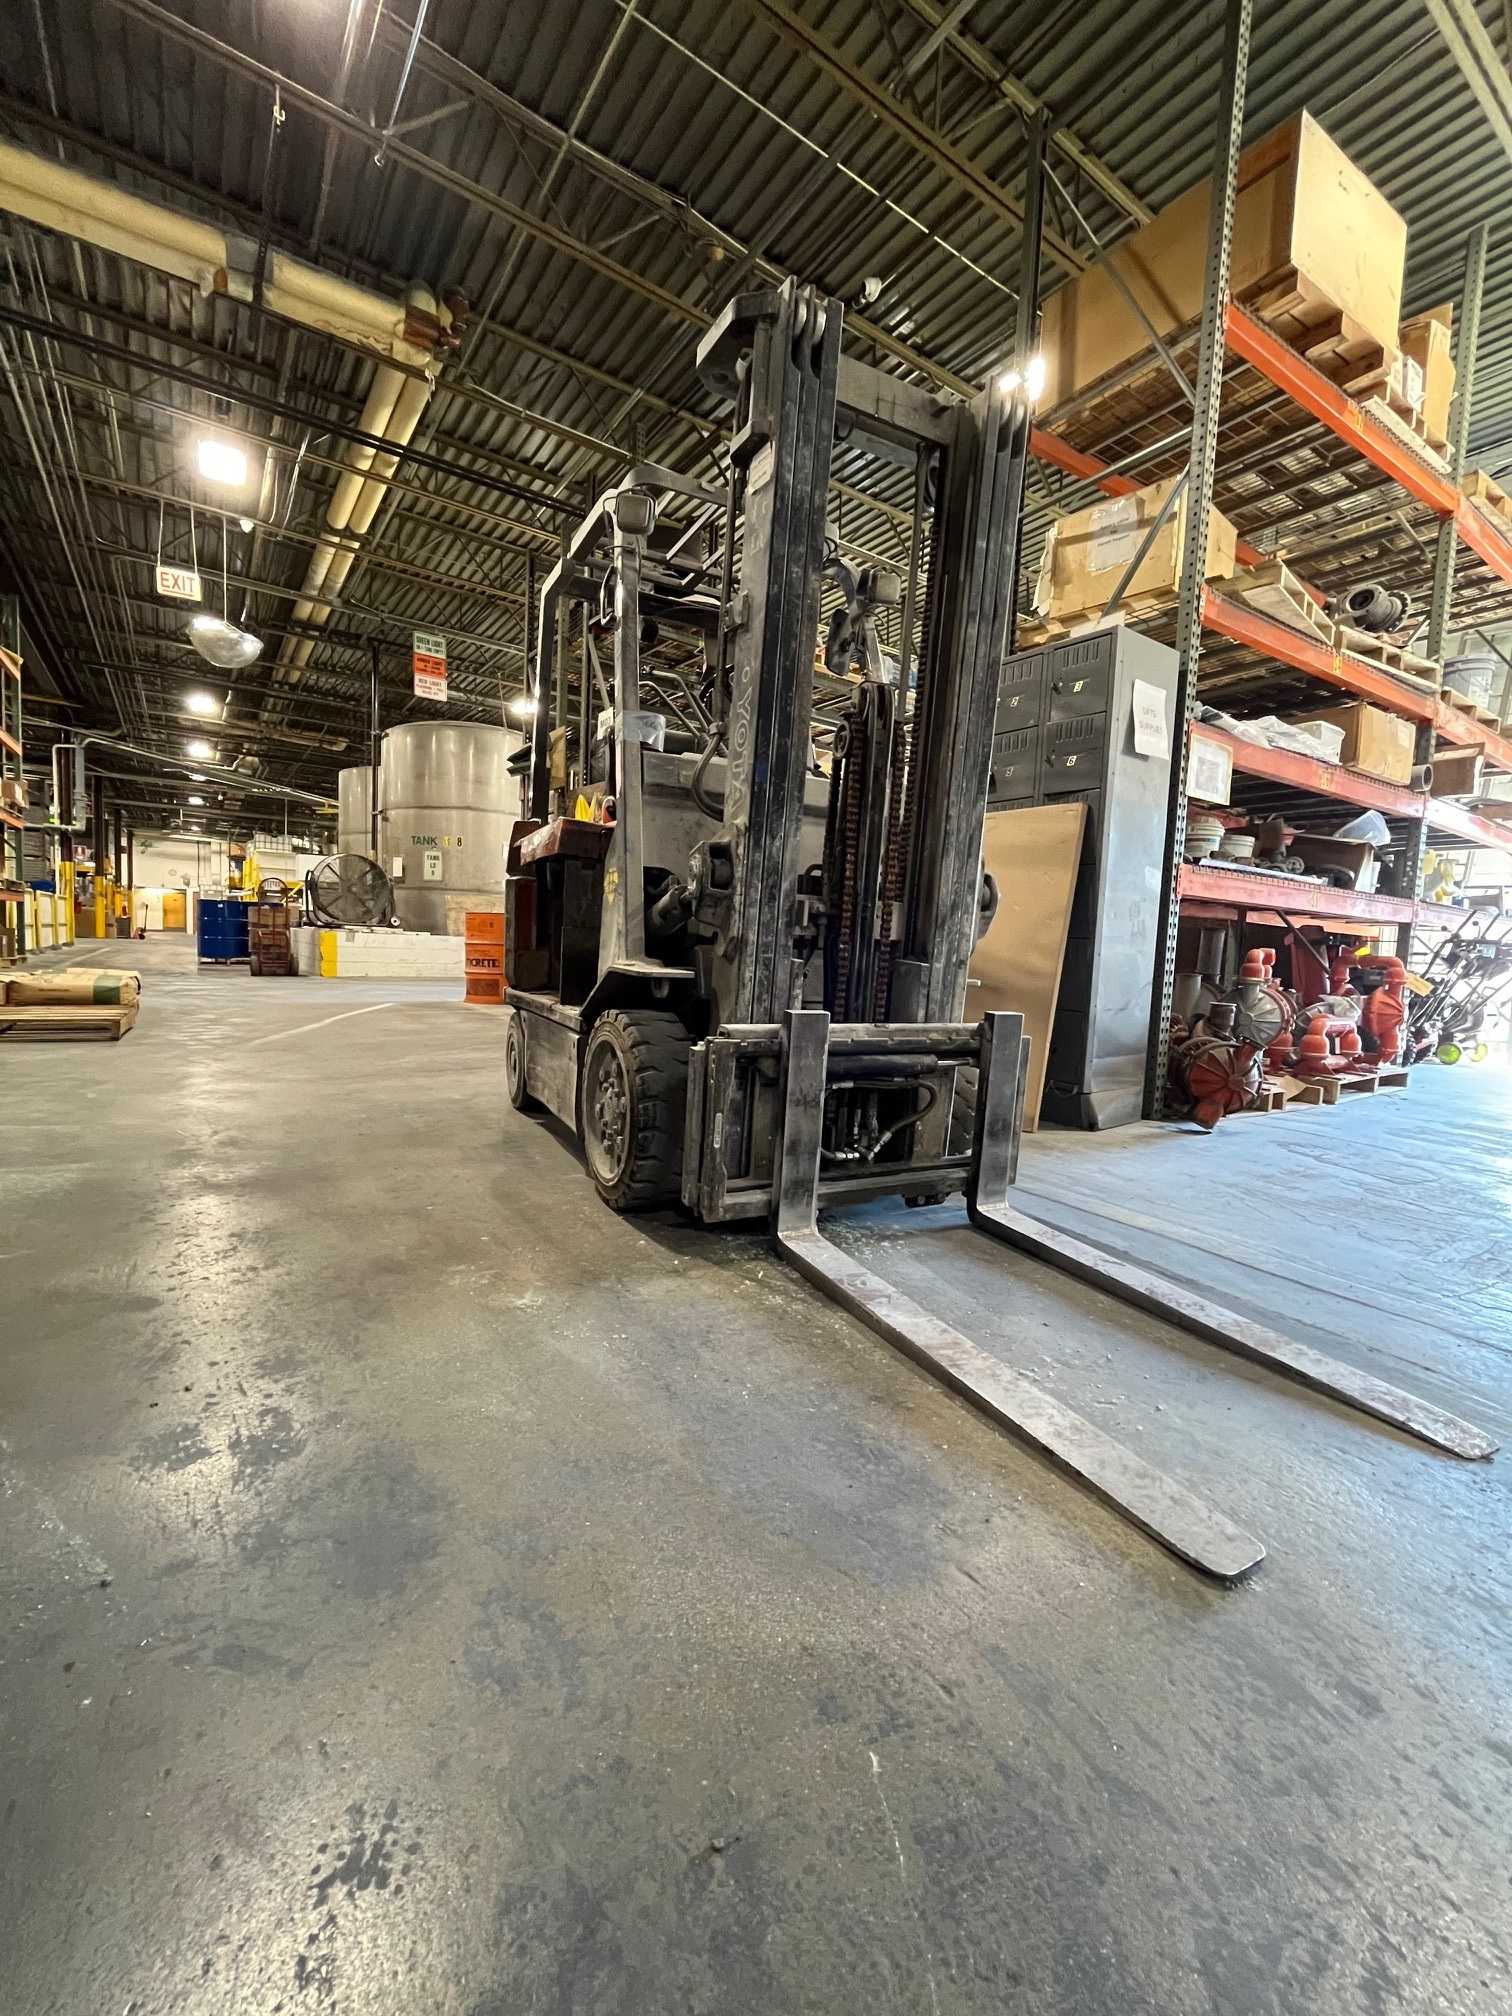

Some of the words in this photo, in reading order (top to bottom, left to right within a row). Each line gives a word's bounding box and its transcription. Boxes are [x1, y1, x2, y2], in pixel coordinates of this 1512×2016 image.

[160, 571, 195, 592] EXIT
[411, 835, 438, 846] TANK
[456, 836, 463, 847] 8
